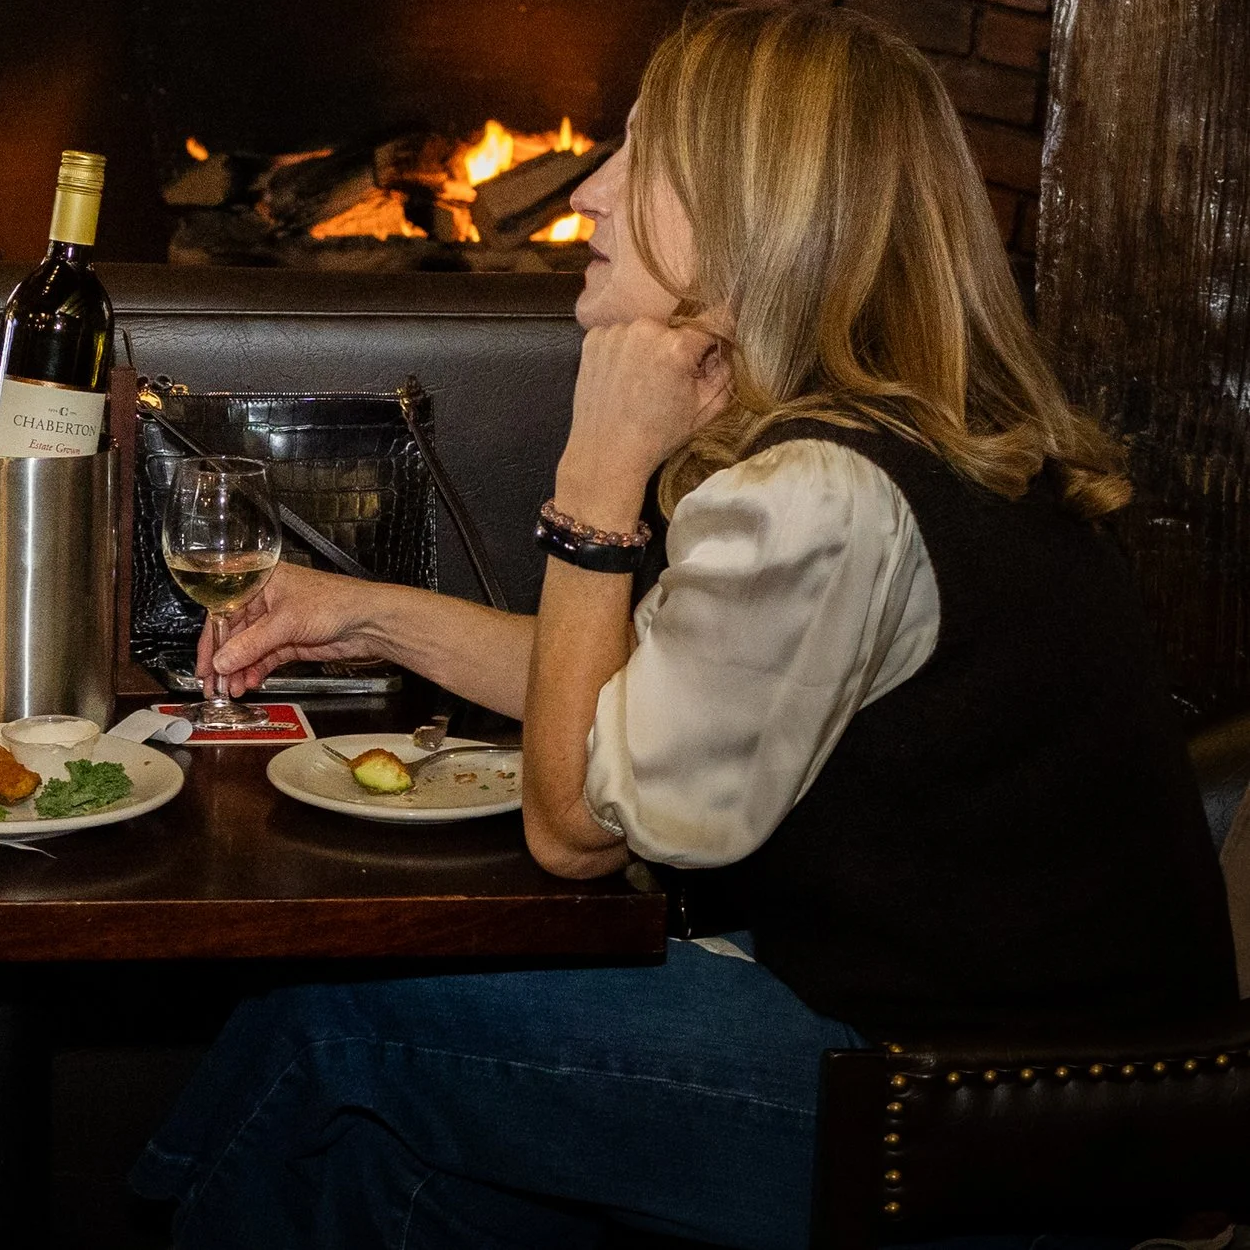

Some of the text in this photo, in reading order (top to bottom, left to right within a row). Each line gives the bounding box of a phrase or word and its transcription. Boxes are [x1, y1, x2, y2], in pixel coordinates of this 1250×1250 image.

[13, 414, 96, 437] CHABERTON
[30, 439, 81, 455] Estate Grown
